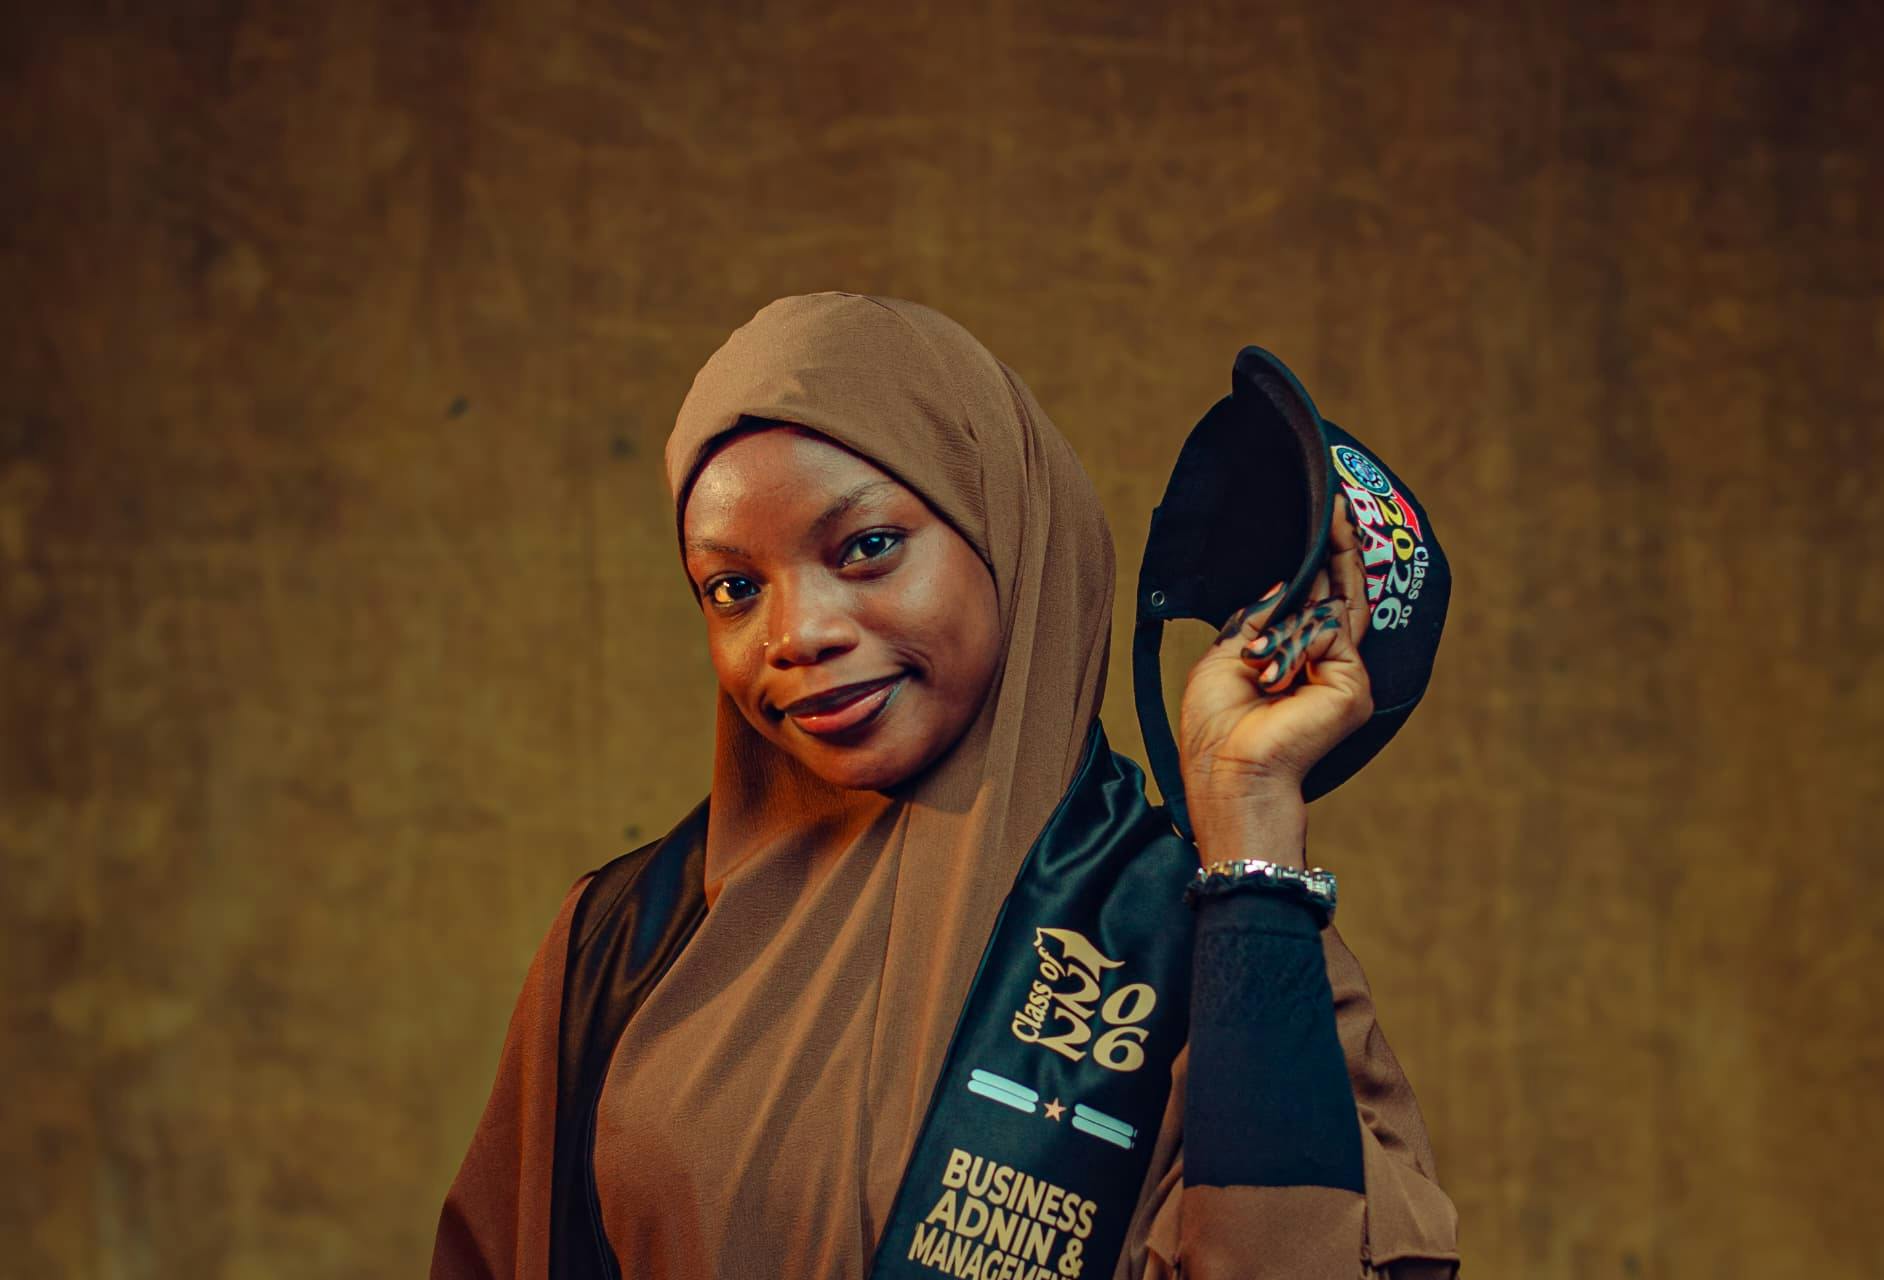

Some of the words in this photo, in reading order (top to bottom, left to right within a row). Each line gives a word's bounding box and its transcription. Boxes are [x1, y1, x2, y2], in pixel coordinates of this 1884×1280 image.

[1372, 496, 1415, 631] 2026
[1408, 546, 1429, 600] Class
[1011, 979, 1053, 1043] Class
[1037, 946, 1067, 982] of
[1038, 1006, 1150, 1073] 26
[1051, 962, 1157, 1026] 20
[925, 1188, 1058, 1267] ADNIN
[1057, 1237, 1084, 1280] &
[941, 1147, 1098, 1240] BUSINESS
